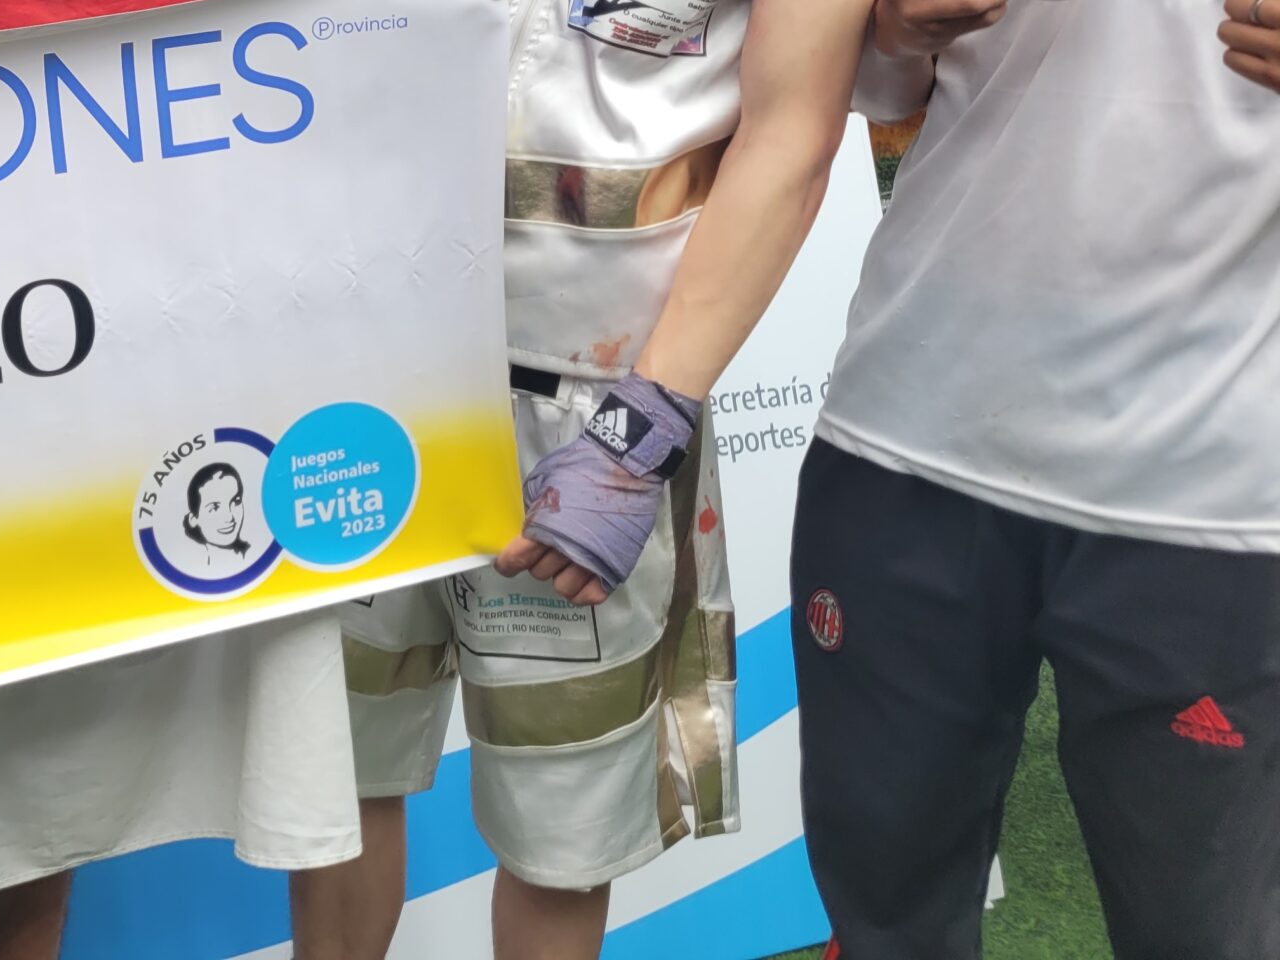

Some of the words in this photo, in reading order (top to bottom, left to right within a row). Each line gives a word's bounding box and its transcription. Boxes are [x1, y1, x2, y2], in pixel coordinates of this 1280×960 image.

[311, 14, 408, 41] Provincia
[290, 448, 346, 472] Juegos
[139, 491, 158, 520] 75
[152, 433, 207, 488] AÑOS
[293, 460, 380, 490] Nacionales
[294, 487, 384, 529] Evita
[340, 514, 386, 538] 2023
[478, 595, 505, 608] Los
[479, 609, 535, 620] FERRETERÍA
[536, 612, 586, 623] CORRALÓN
